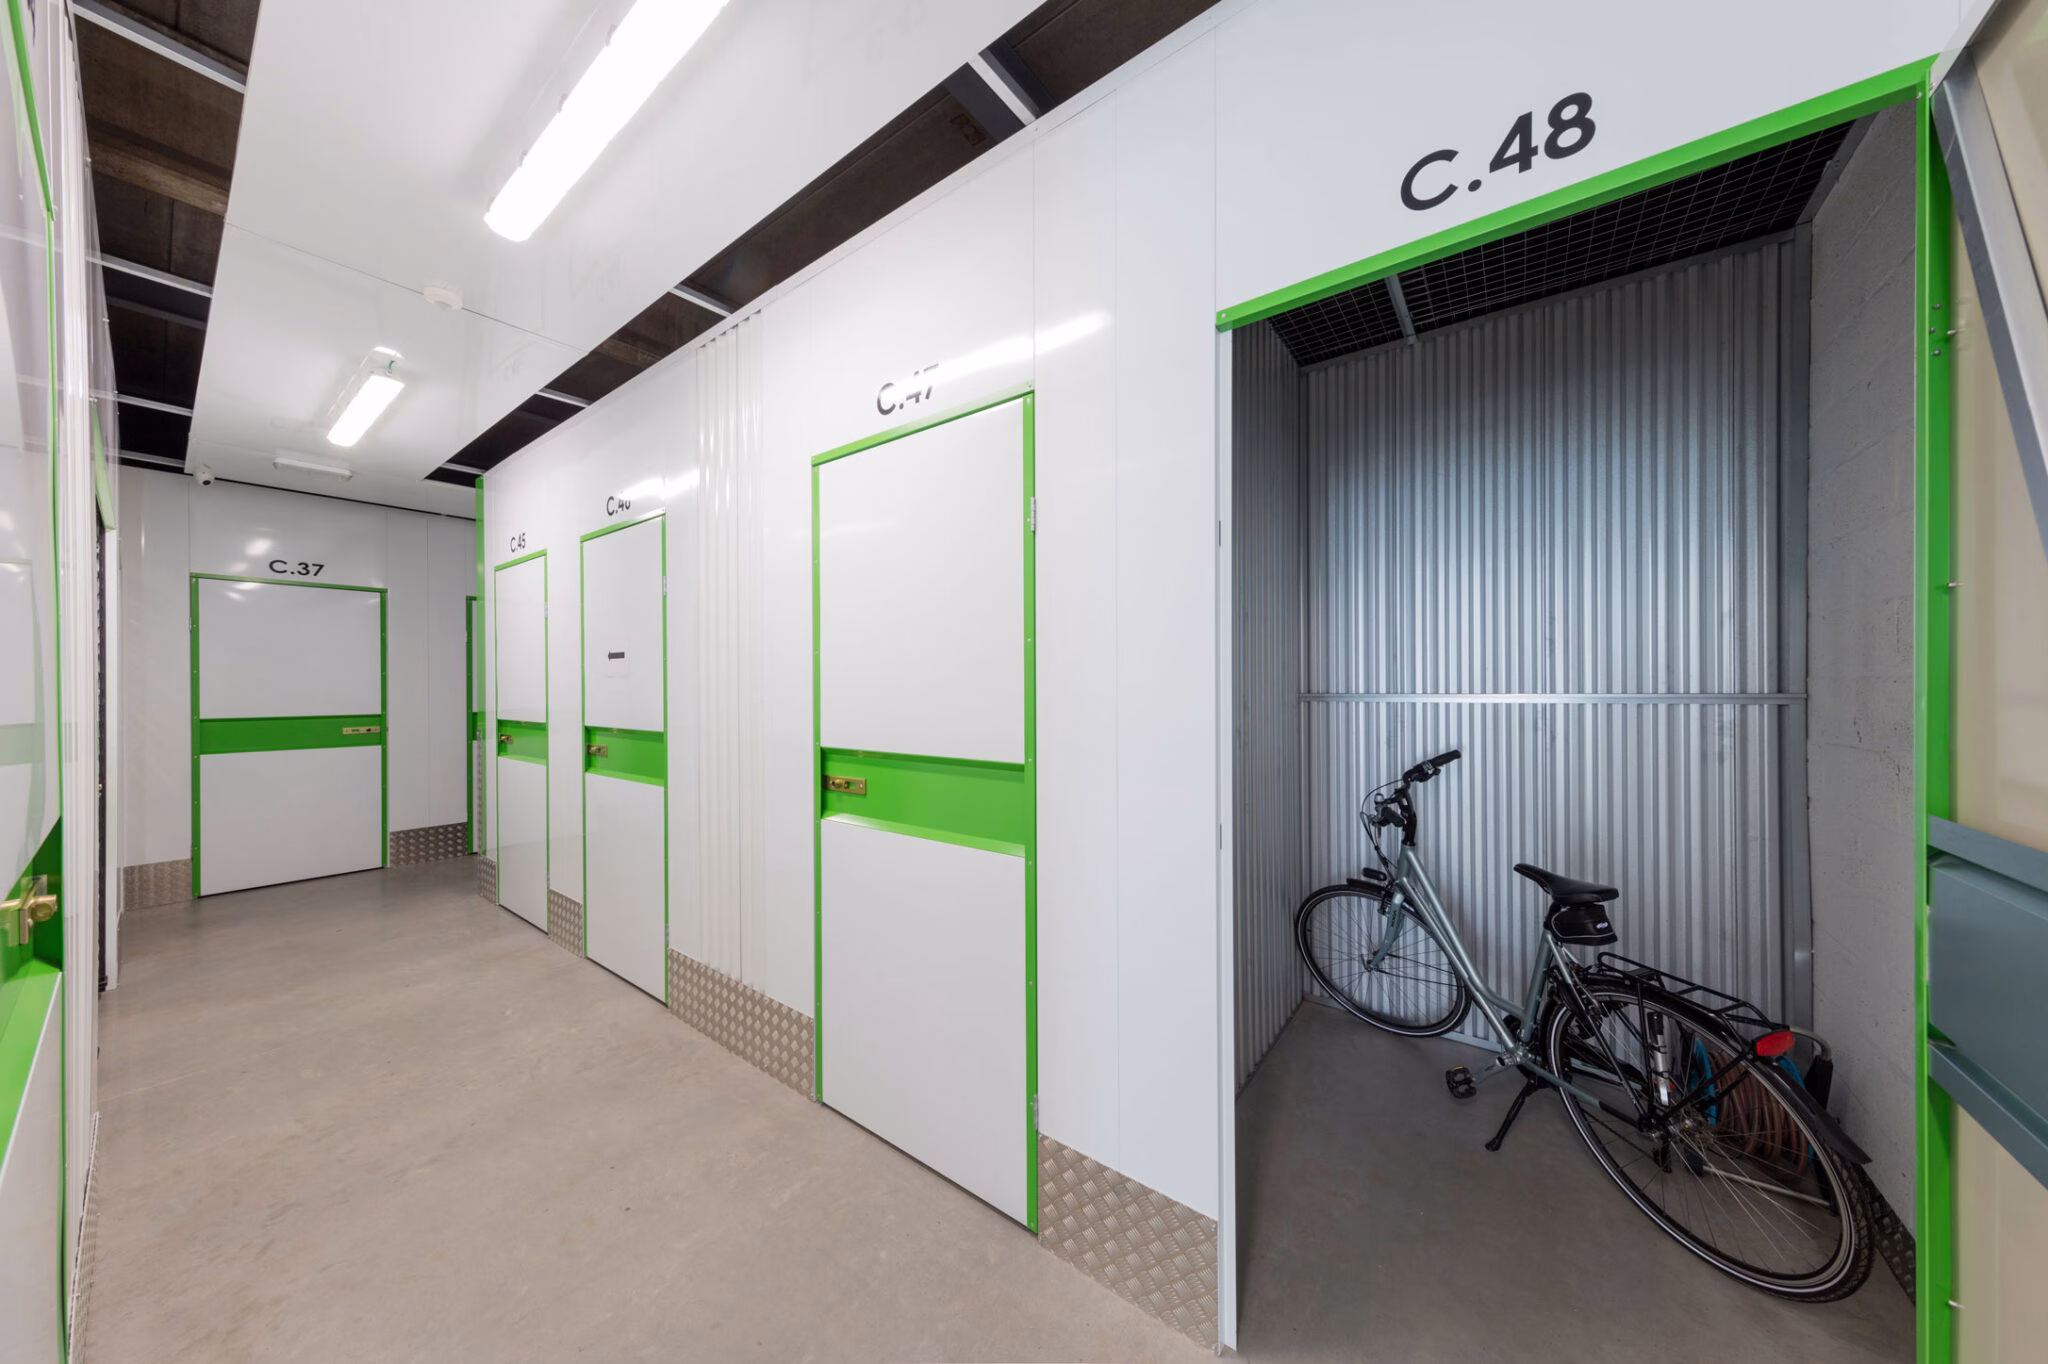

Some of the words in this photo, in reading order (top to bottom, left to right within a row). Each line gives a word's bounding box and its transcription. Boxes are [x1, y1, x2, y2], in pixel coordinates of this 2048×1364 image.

[1400, 92, 1596, 211] C.48
[510, 532, 526, 553] C.45
[268, 559, 325, 577] C.37
